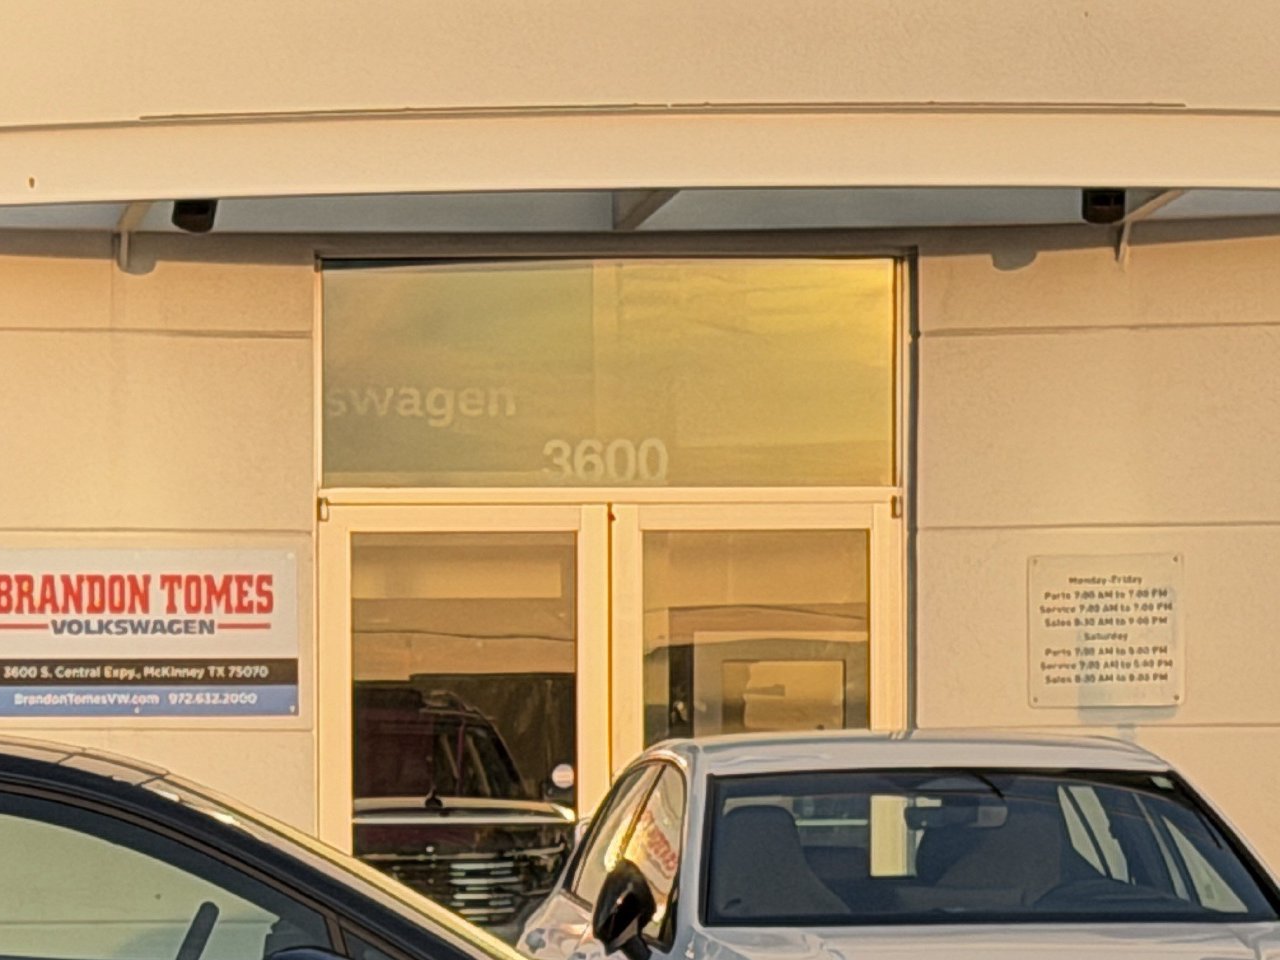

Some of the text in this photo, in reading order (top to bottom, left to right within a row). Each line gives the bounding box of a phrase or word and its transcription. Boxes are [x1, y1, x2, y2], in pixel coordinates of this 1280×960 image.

[542, 437, 669, 483] 3600
[160, 574, 274, 614] TOMES
[51, 619, 215, 635] VOLKSWAGEN
[3, 665, 38, 679] 3600
[40, 665, 53, 679] S.
[54, 665, 101, 679] Central
[144, 665, 205, 680] McKinney
[207, 665, 226, 678] TX
[228, 665, 270, 678] 75070
[14, 693, 160, 706] BrandonTomesVW.com
